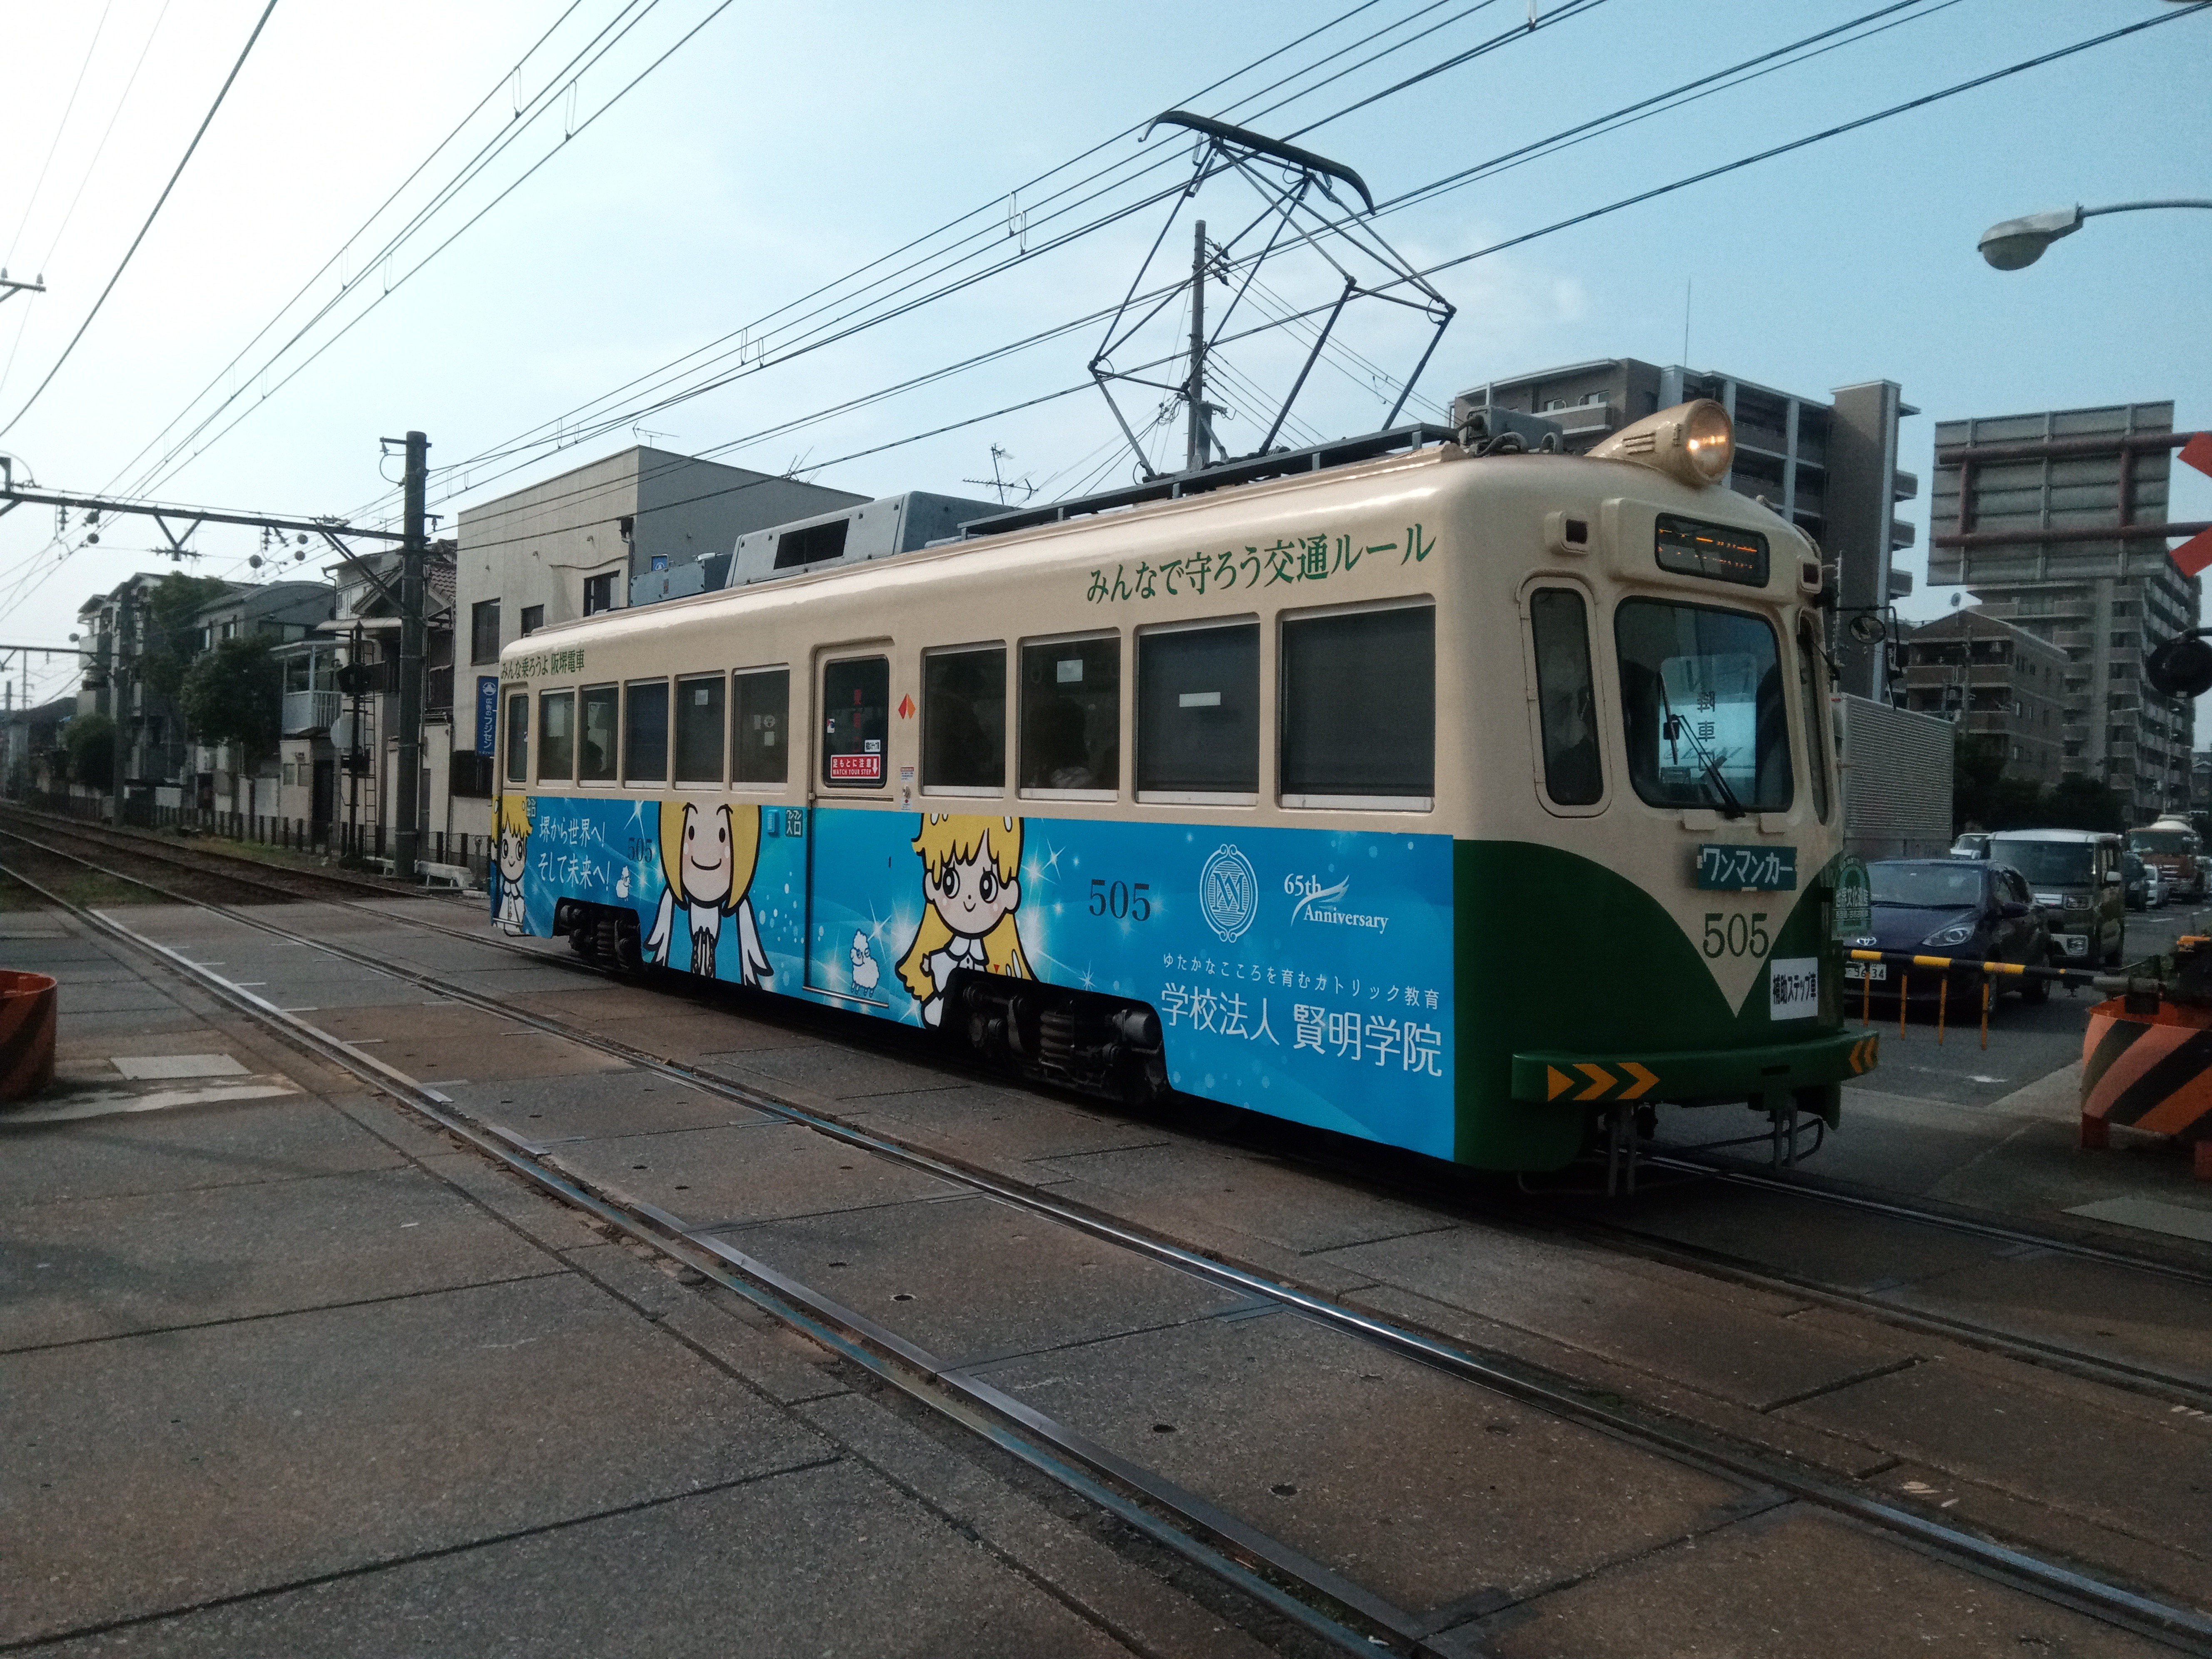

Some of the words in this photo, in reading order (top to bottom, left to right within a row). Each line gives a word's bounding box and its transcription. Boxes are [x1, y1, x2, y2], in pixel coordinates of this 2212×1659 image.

[1086, 523, 1437, 604] みんなで守ろう交通ルール
[501, 656, 548, 680] みんな乗ろうよ
[551, 648, 584, 676] 阪堺電車
[833, 758, 872, 768] 足もとに注意
[786, 820, 801, 835] 入口
[628, 837, 653, 863] 505
[1703, 848, 1794, 885] ワンマンカー
[1089, 878, 1151, 922] 505
[1284, 873, 1322, 897] 65th
[1303, 903, 1390, 934] Anniversary
[1702, 912, 1769, 958] 505
[1163, 952, 1440, 1010] ゆたかなこころを育むカトリック教育
[1161, 982, 1280, 1046] 学校法人
[1293, 1004, 1442, 1078] 賢明学院
